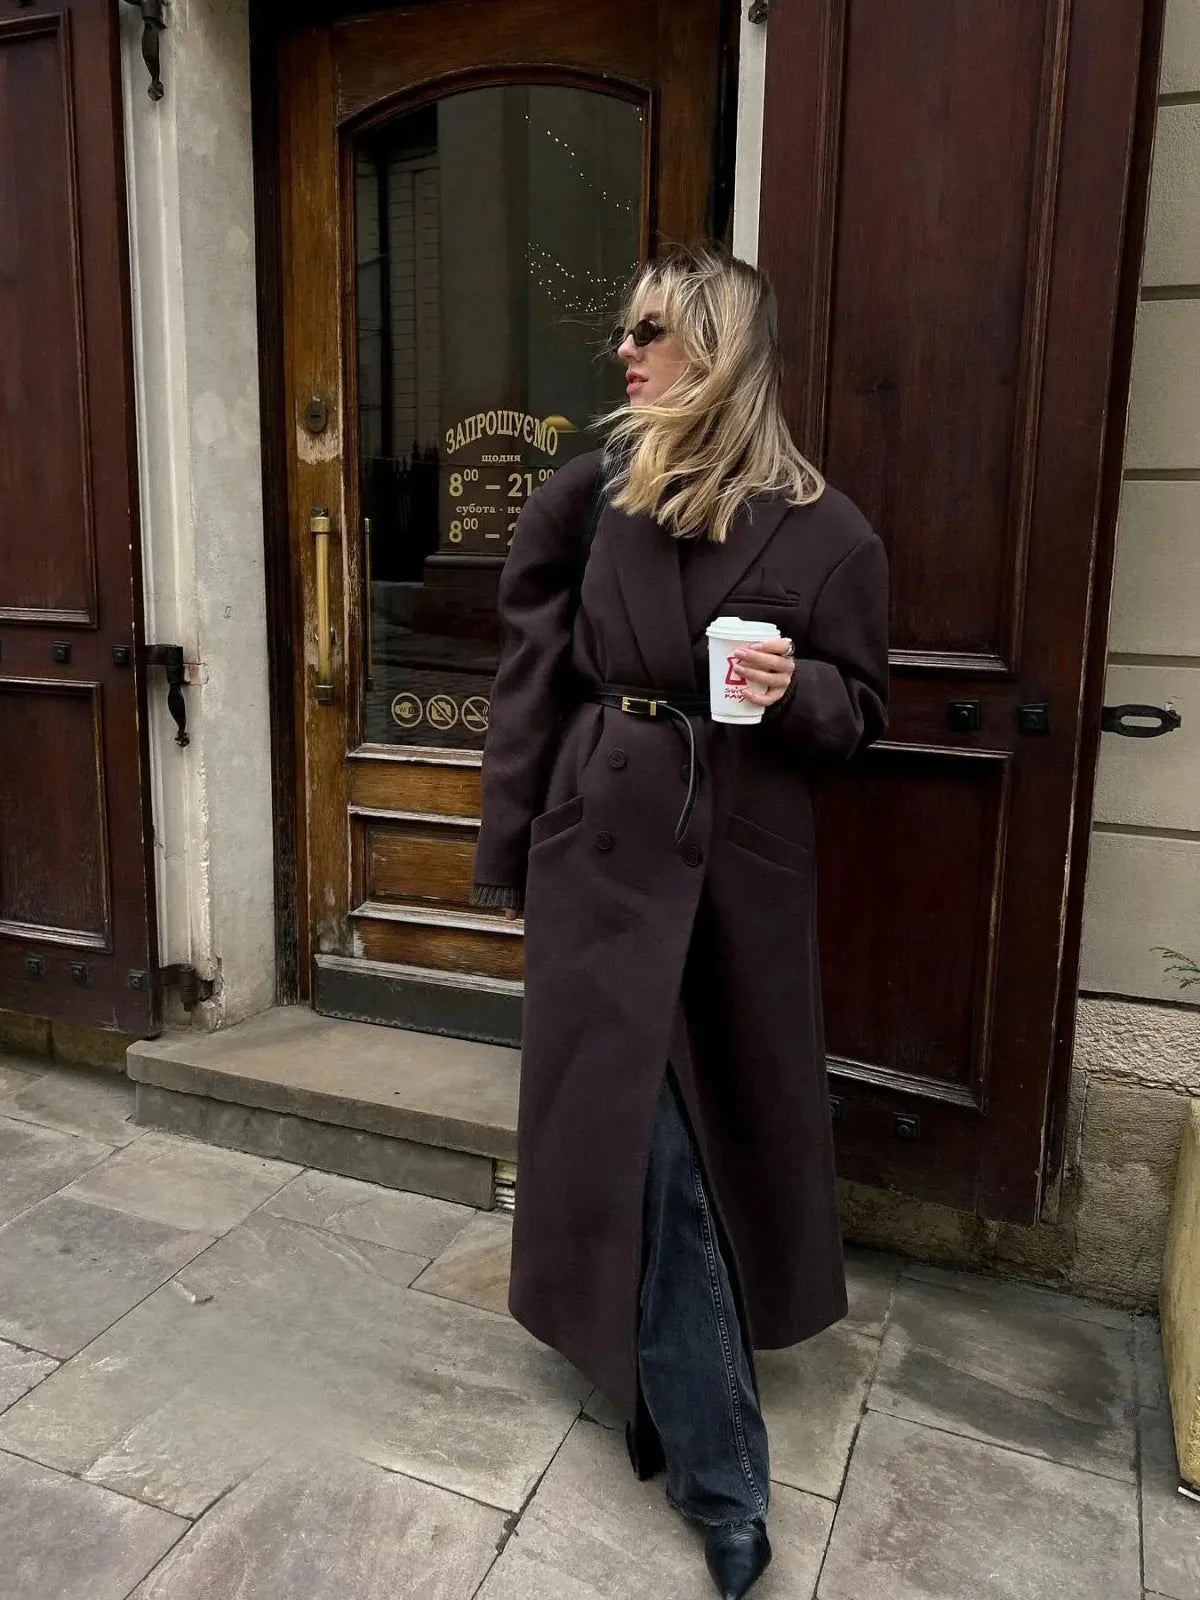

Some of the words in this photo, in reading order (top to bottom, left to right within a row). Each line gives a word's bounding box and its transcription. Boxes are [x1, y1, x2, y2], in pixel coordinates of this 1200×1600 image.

[446, 410, 558, 456] ЗАПРОШУЄМО
[481, 454, 521, 463] щодня
[456, 503, 496, 515] субота
